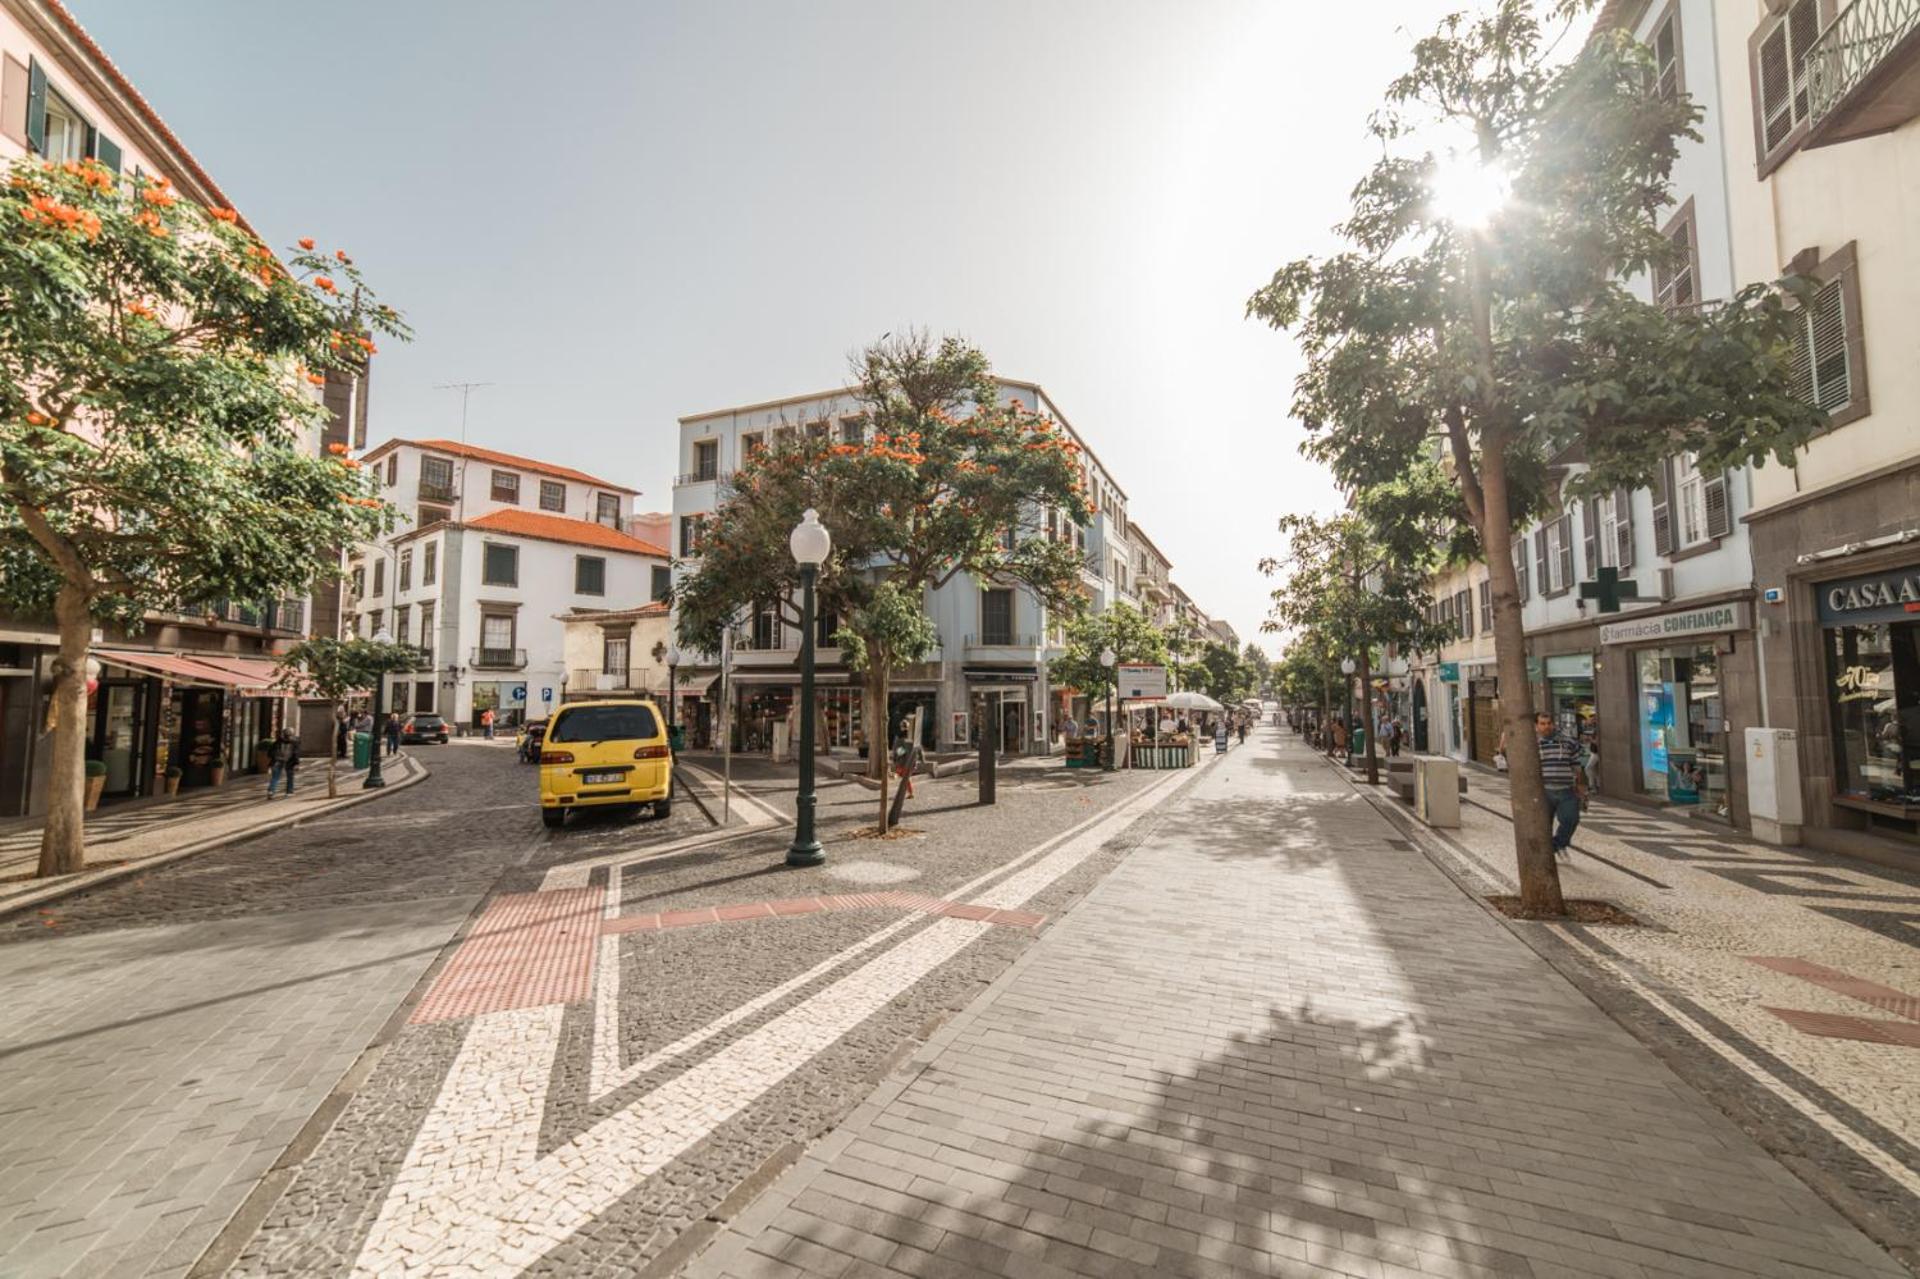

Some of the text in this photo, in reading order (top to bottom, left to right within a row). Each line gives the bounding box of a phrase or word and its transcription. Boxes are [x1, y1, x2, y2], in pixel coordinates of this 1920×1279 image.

[1828, 575, 1920, 611] CASA A
[1664, 609, 1734, 632] CONFIANÇA
